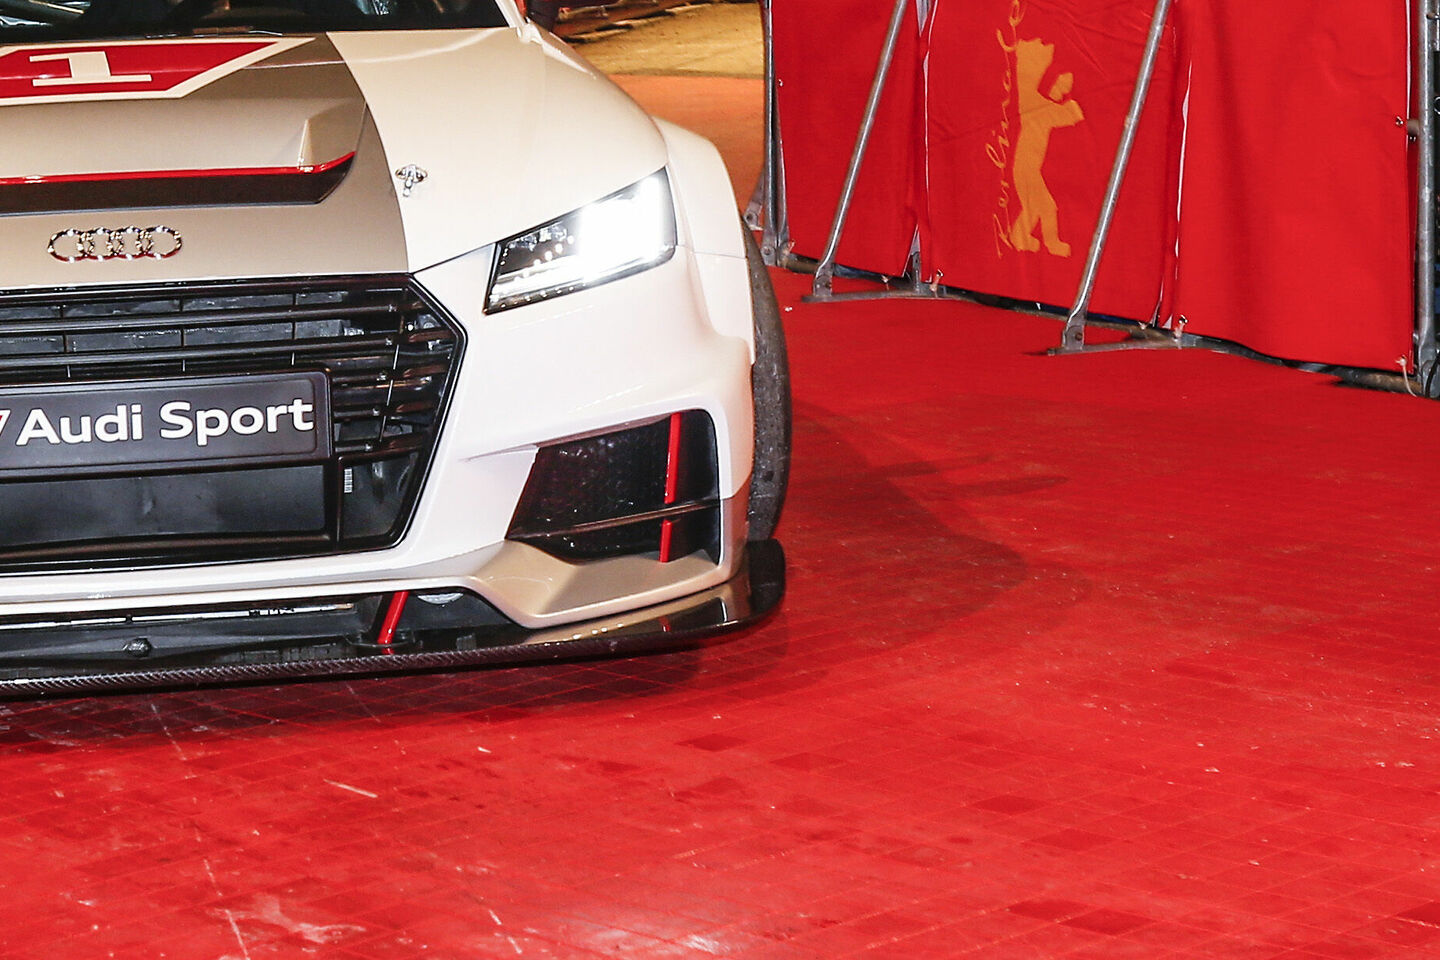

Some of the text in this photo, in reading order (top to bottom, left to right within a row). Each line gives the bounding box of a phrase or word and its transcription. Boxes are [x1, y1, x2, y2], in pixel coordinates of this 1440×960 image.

[29, 51, 152, 87] 1
[16, 398, 315, 446] Audi Sport
